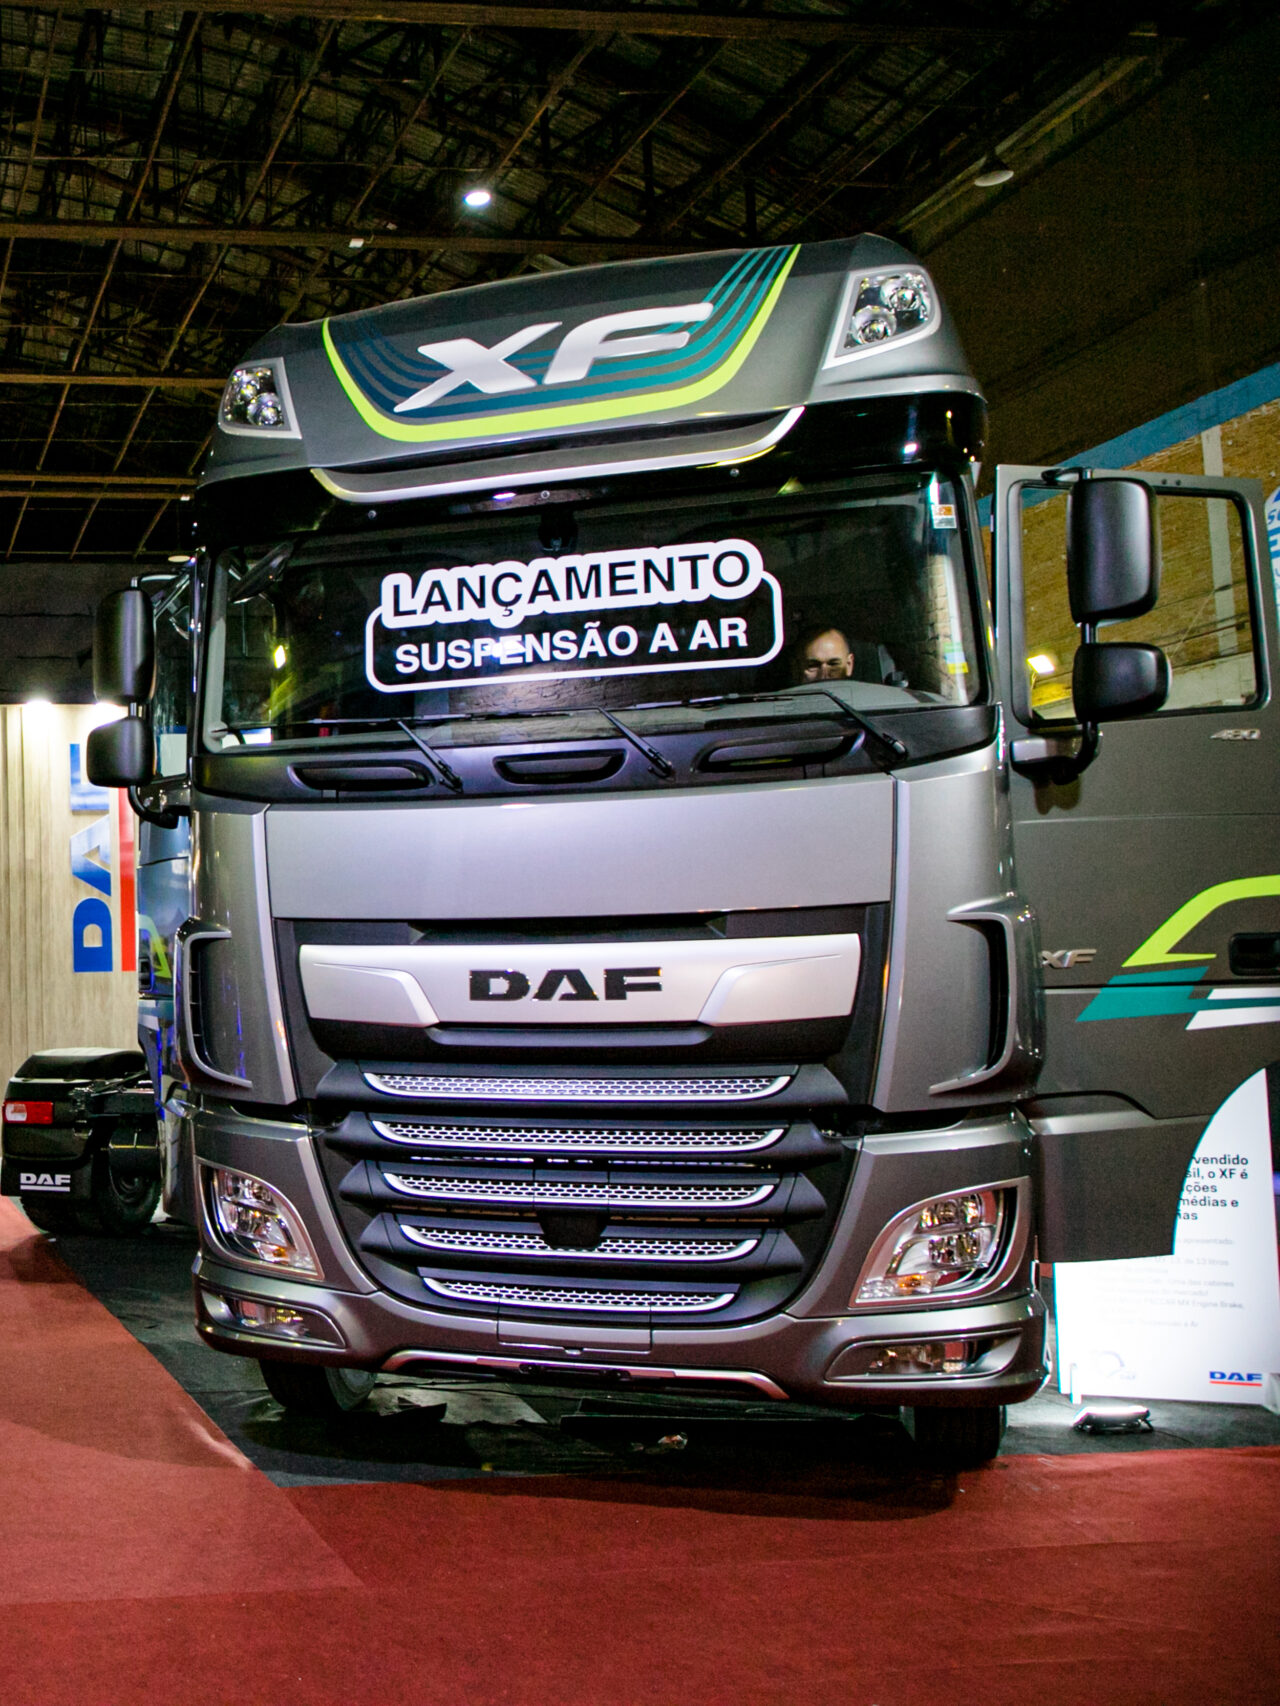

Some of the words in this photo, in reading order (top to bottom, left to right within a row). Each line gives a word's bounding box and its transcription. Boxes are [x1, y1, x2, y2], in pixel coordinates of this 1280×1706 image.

[393, 302, 714, 413] XF
[393, 550, 751, 617] LANÇAMENTO
[395, 621, 639, 674] SUSPENSÃO
[649, 623, 678, 653] A
[689, 617, 748, 649] AR
[70, 743, 113, 972] DAF
[1040, 949, 1097, 968] XF
[468, 967, 662, 1001] DAF
[20, 1172, 71, 1186] DAF
[1208, 1171, 1215, 1179] o
[1220, 1168, 1236, 1179] XF
[1240, 1168, 1248, 1179] é
[1231, 1200, 1239, 1208] e
[1209, 1371, 1263, 1382] DAF
